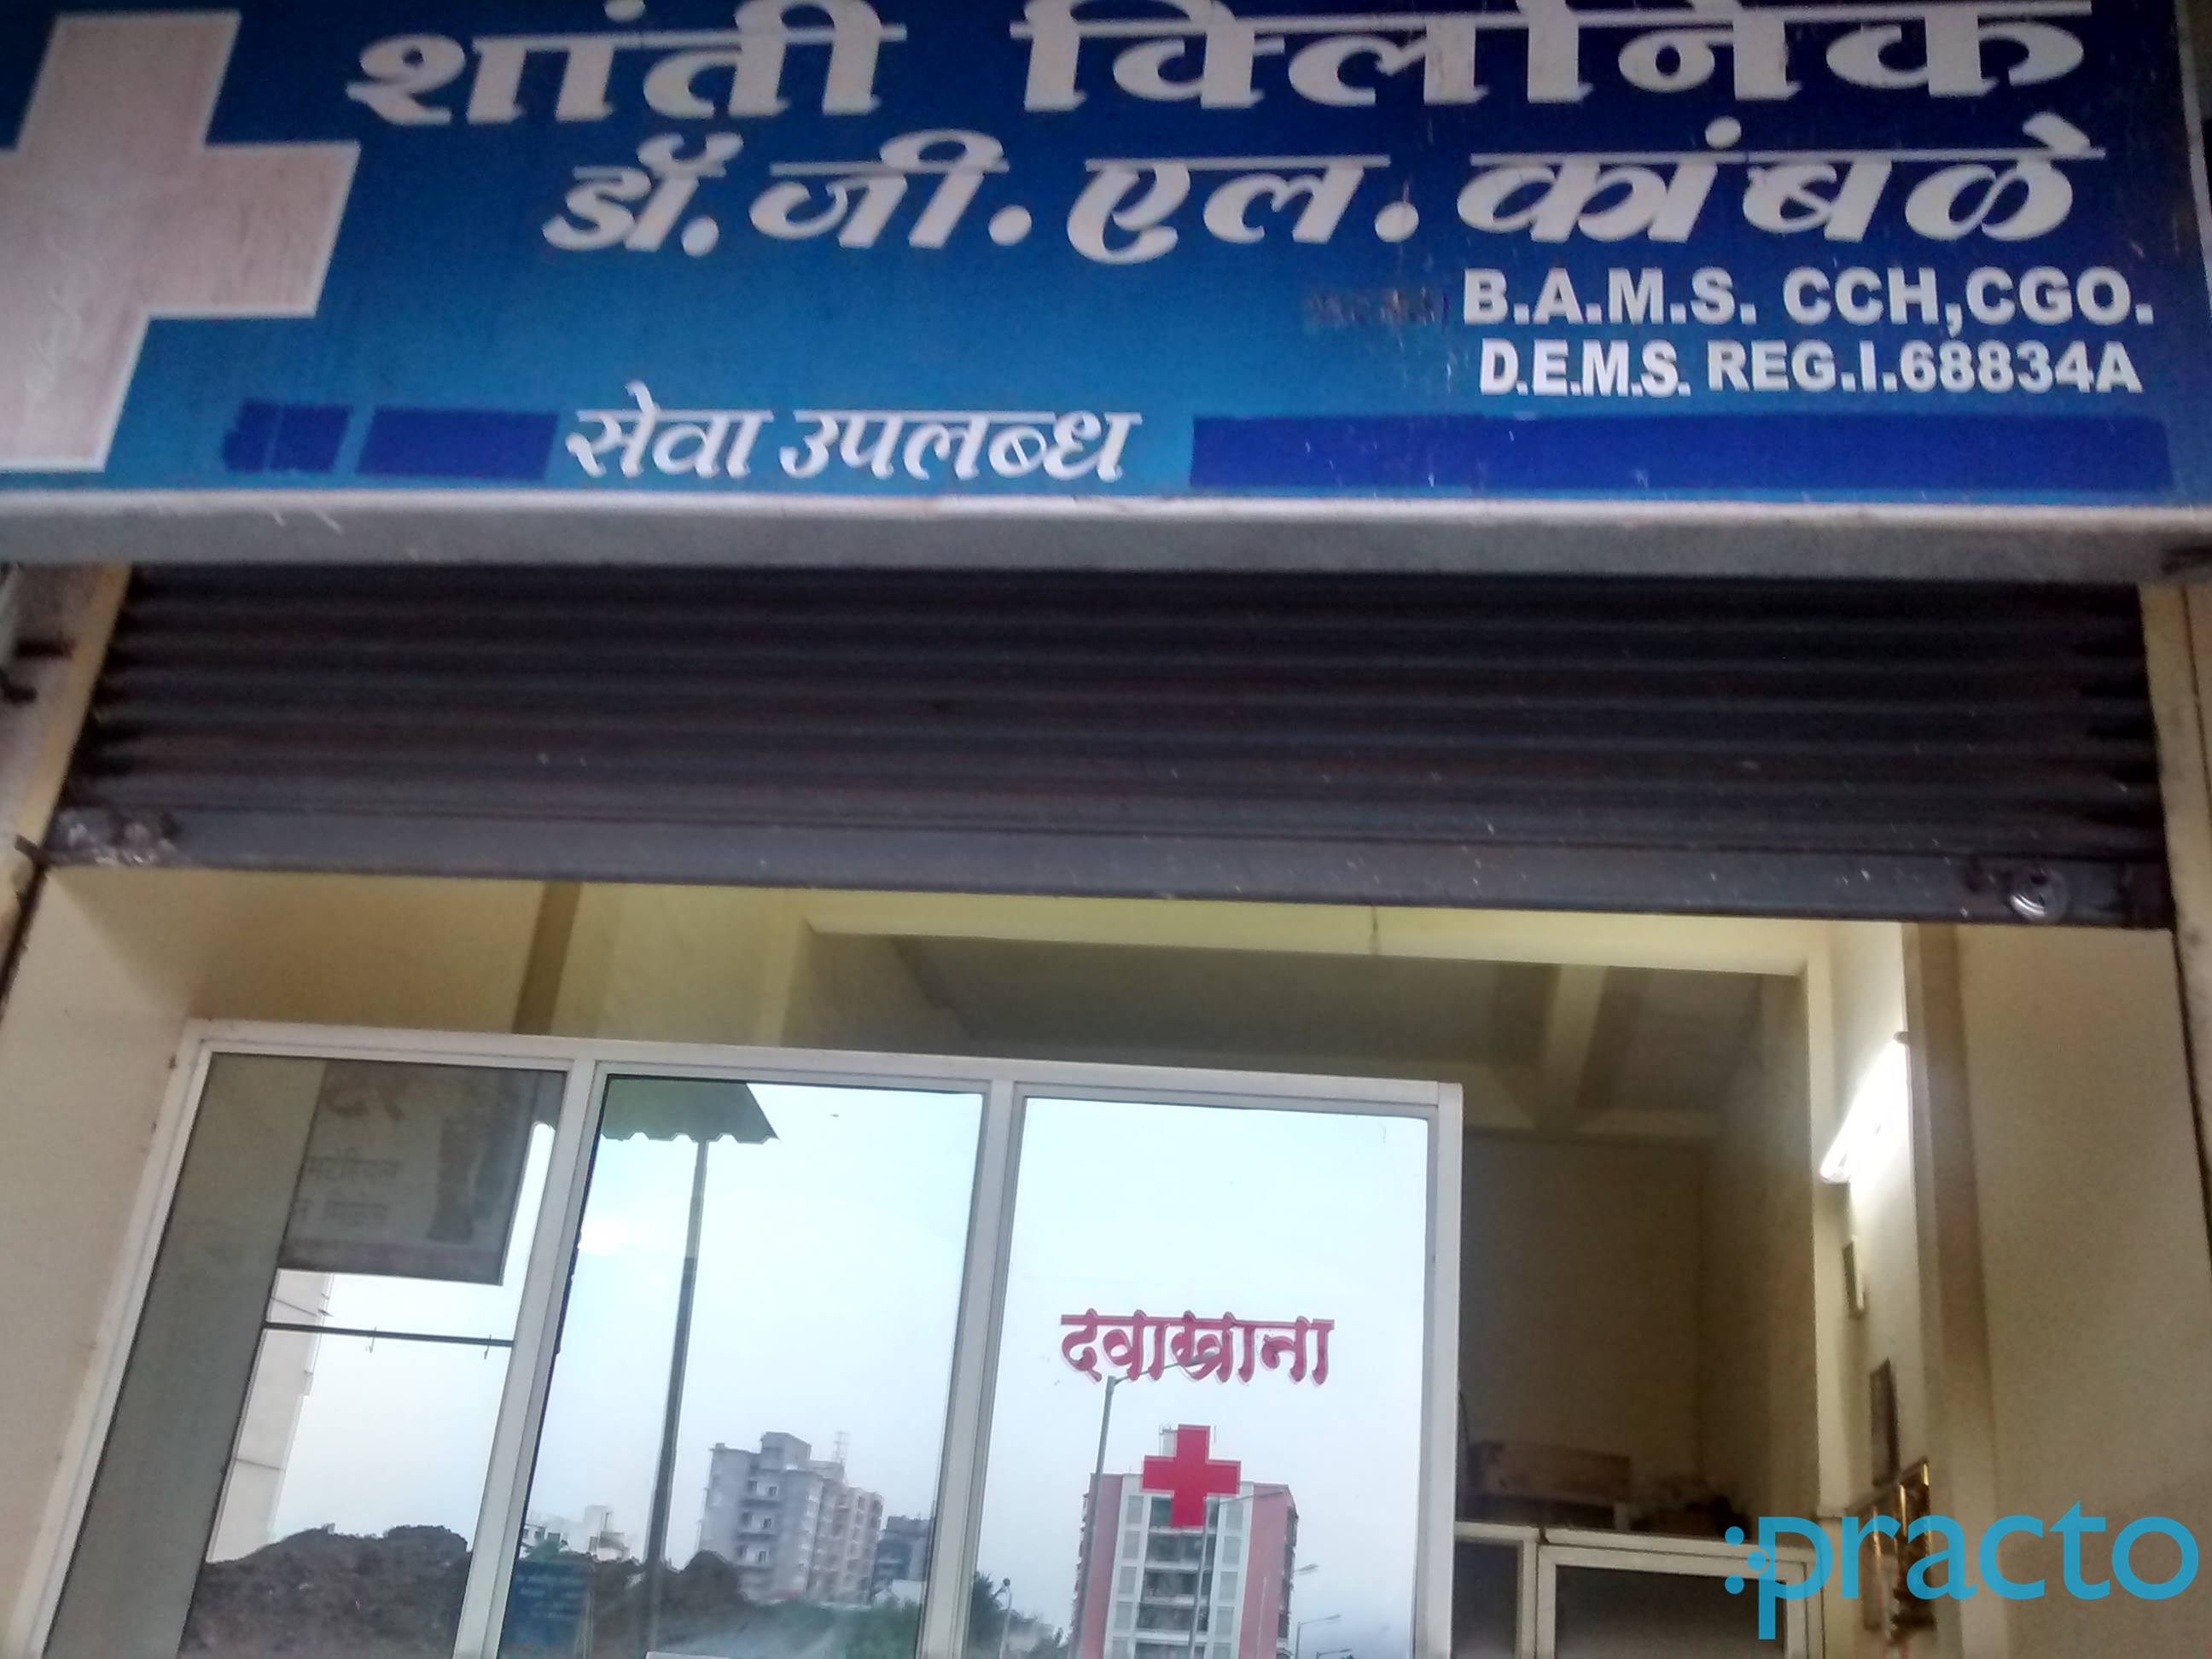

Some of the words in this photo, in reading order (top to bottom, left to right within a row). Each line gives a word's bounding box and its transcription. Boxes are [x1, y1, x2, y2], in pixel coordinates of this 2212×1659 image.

[346, 0, 907, 125] शांती
[1010, 0, 2093, 112] क्लिनिक
[1463, 265, 1758, 326] B.A.M.S.
[1479, 337, 1692, 399] D.E.M.S.
[566, 380, 775, 480] सेवा
[780, 409, 1144, 482] उपलब्ध
[1060, 1308, 1336, 1387] दवाखाना
